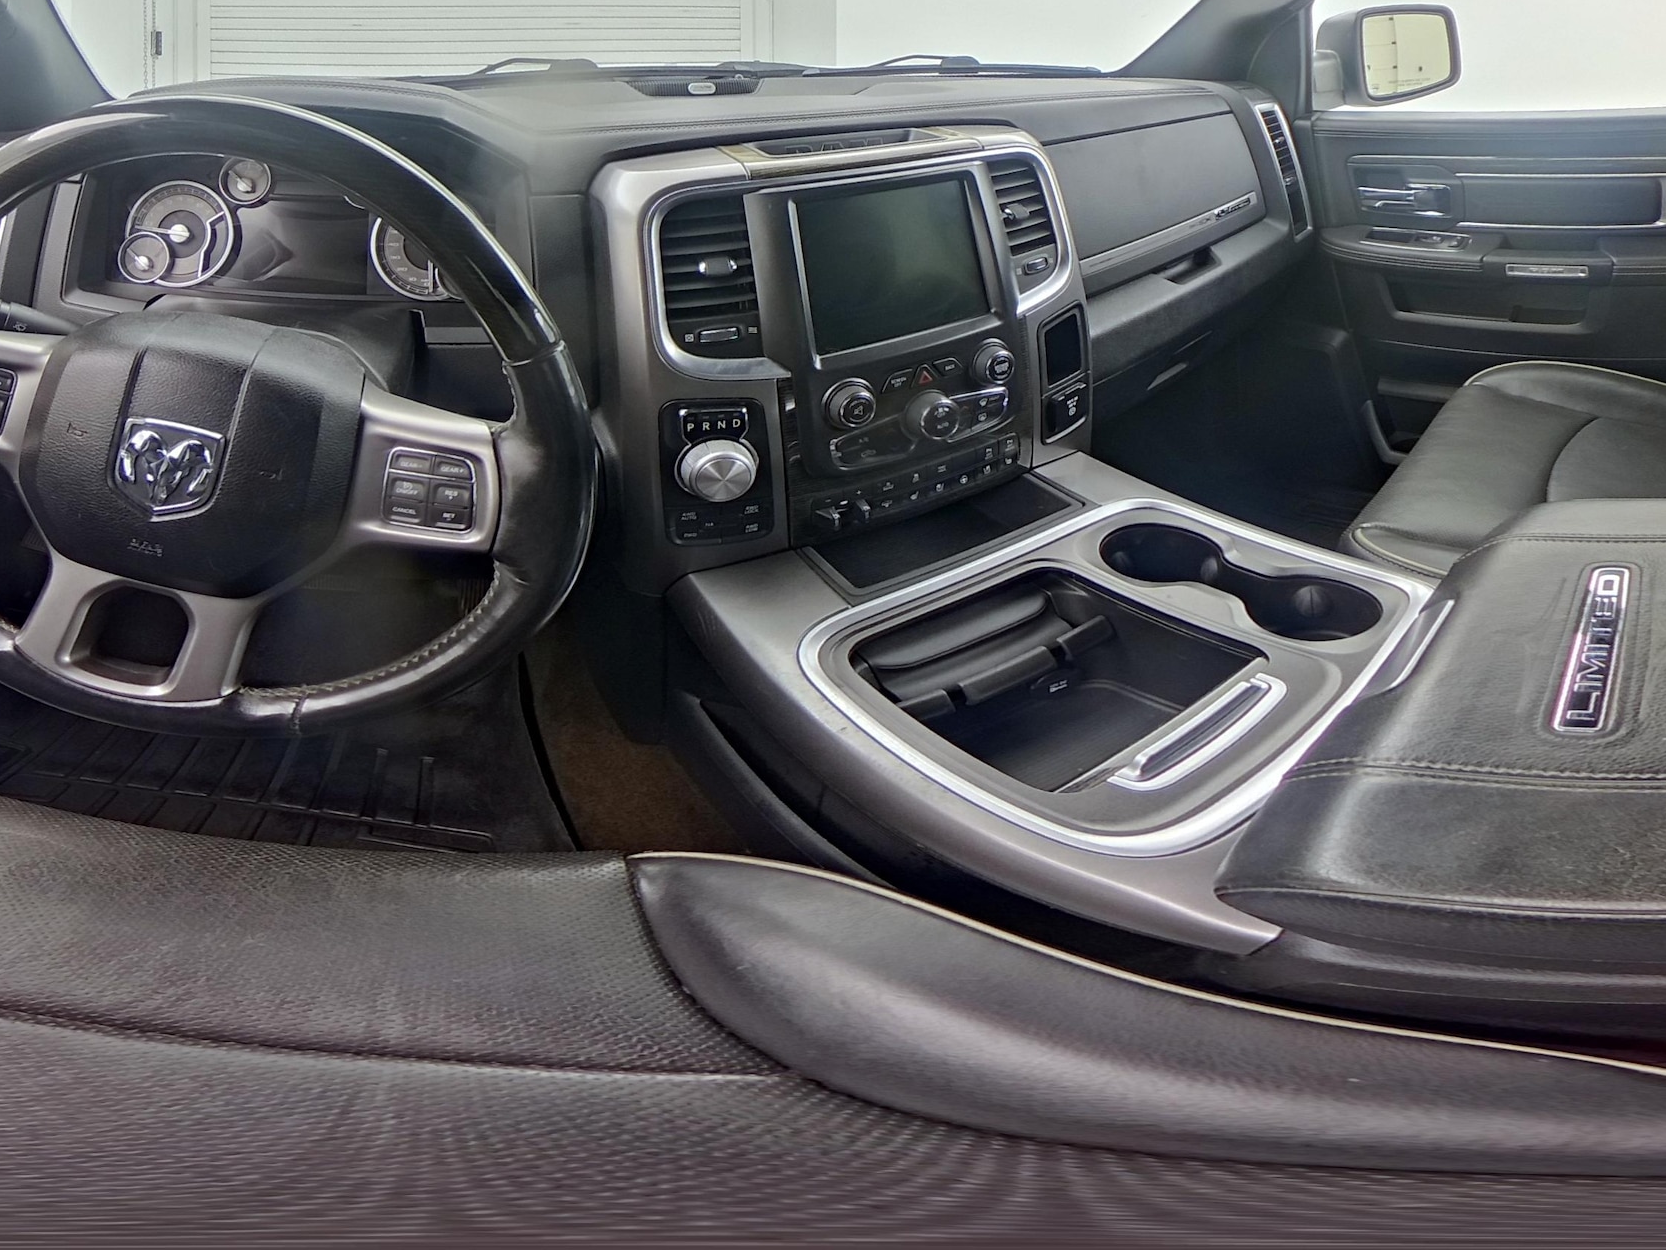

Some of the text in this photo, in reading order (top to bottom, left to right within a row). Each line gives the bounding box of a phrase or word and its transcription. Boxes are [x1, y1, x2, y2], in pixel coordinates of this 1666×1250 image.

[687, 418, 742, 433] P R N D
[440, 466, 459, 474] GEAR
[444, 489, 459, 497] RES
[392, 506, 417, 515] CANCEL
[1566, 574, 1621, 721] LIMITED
